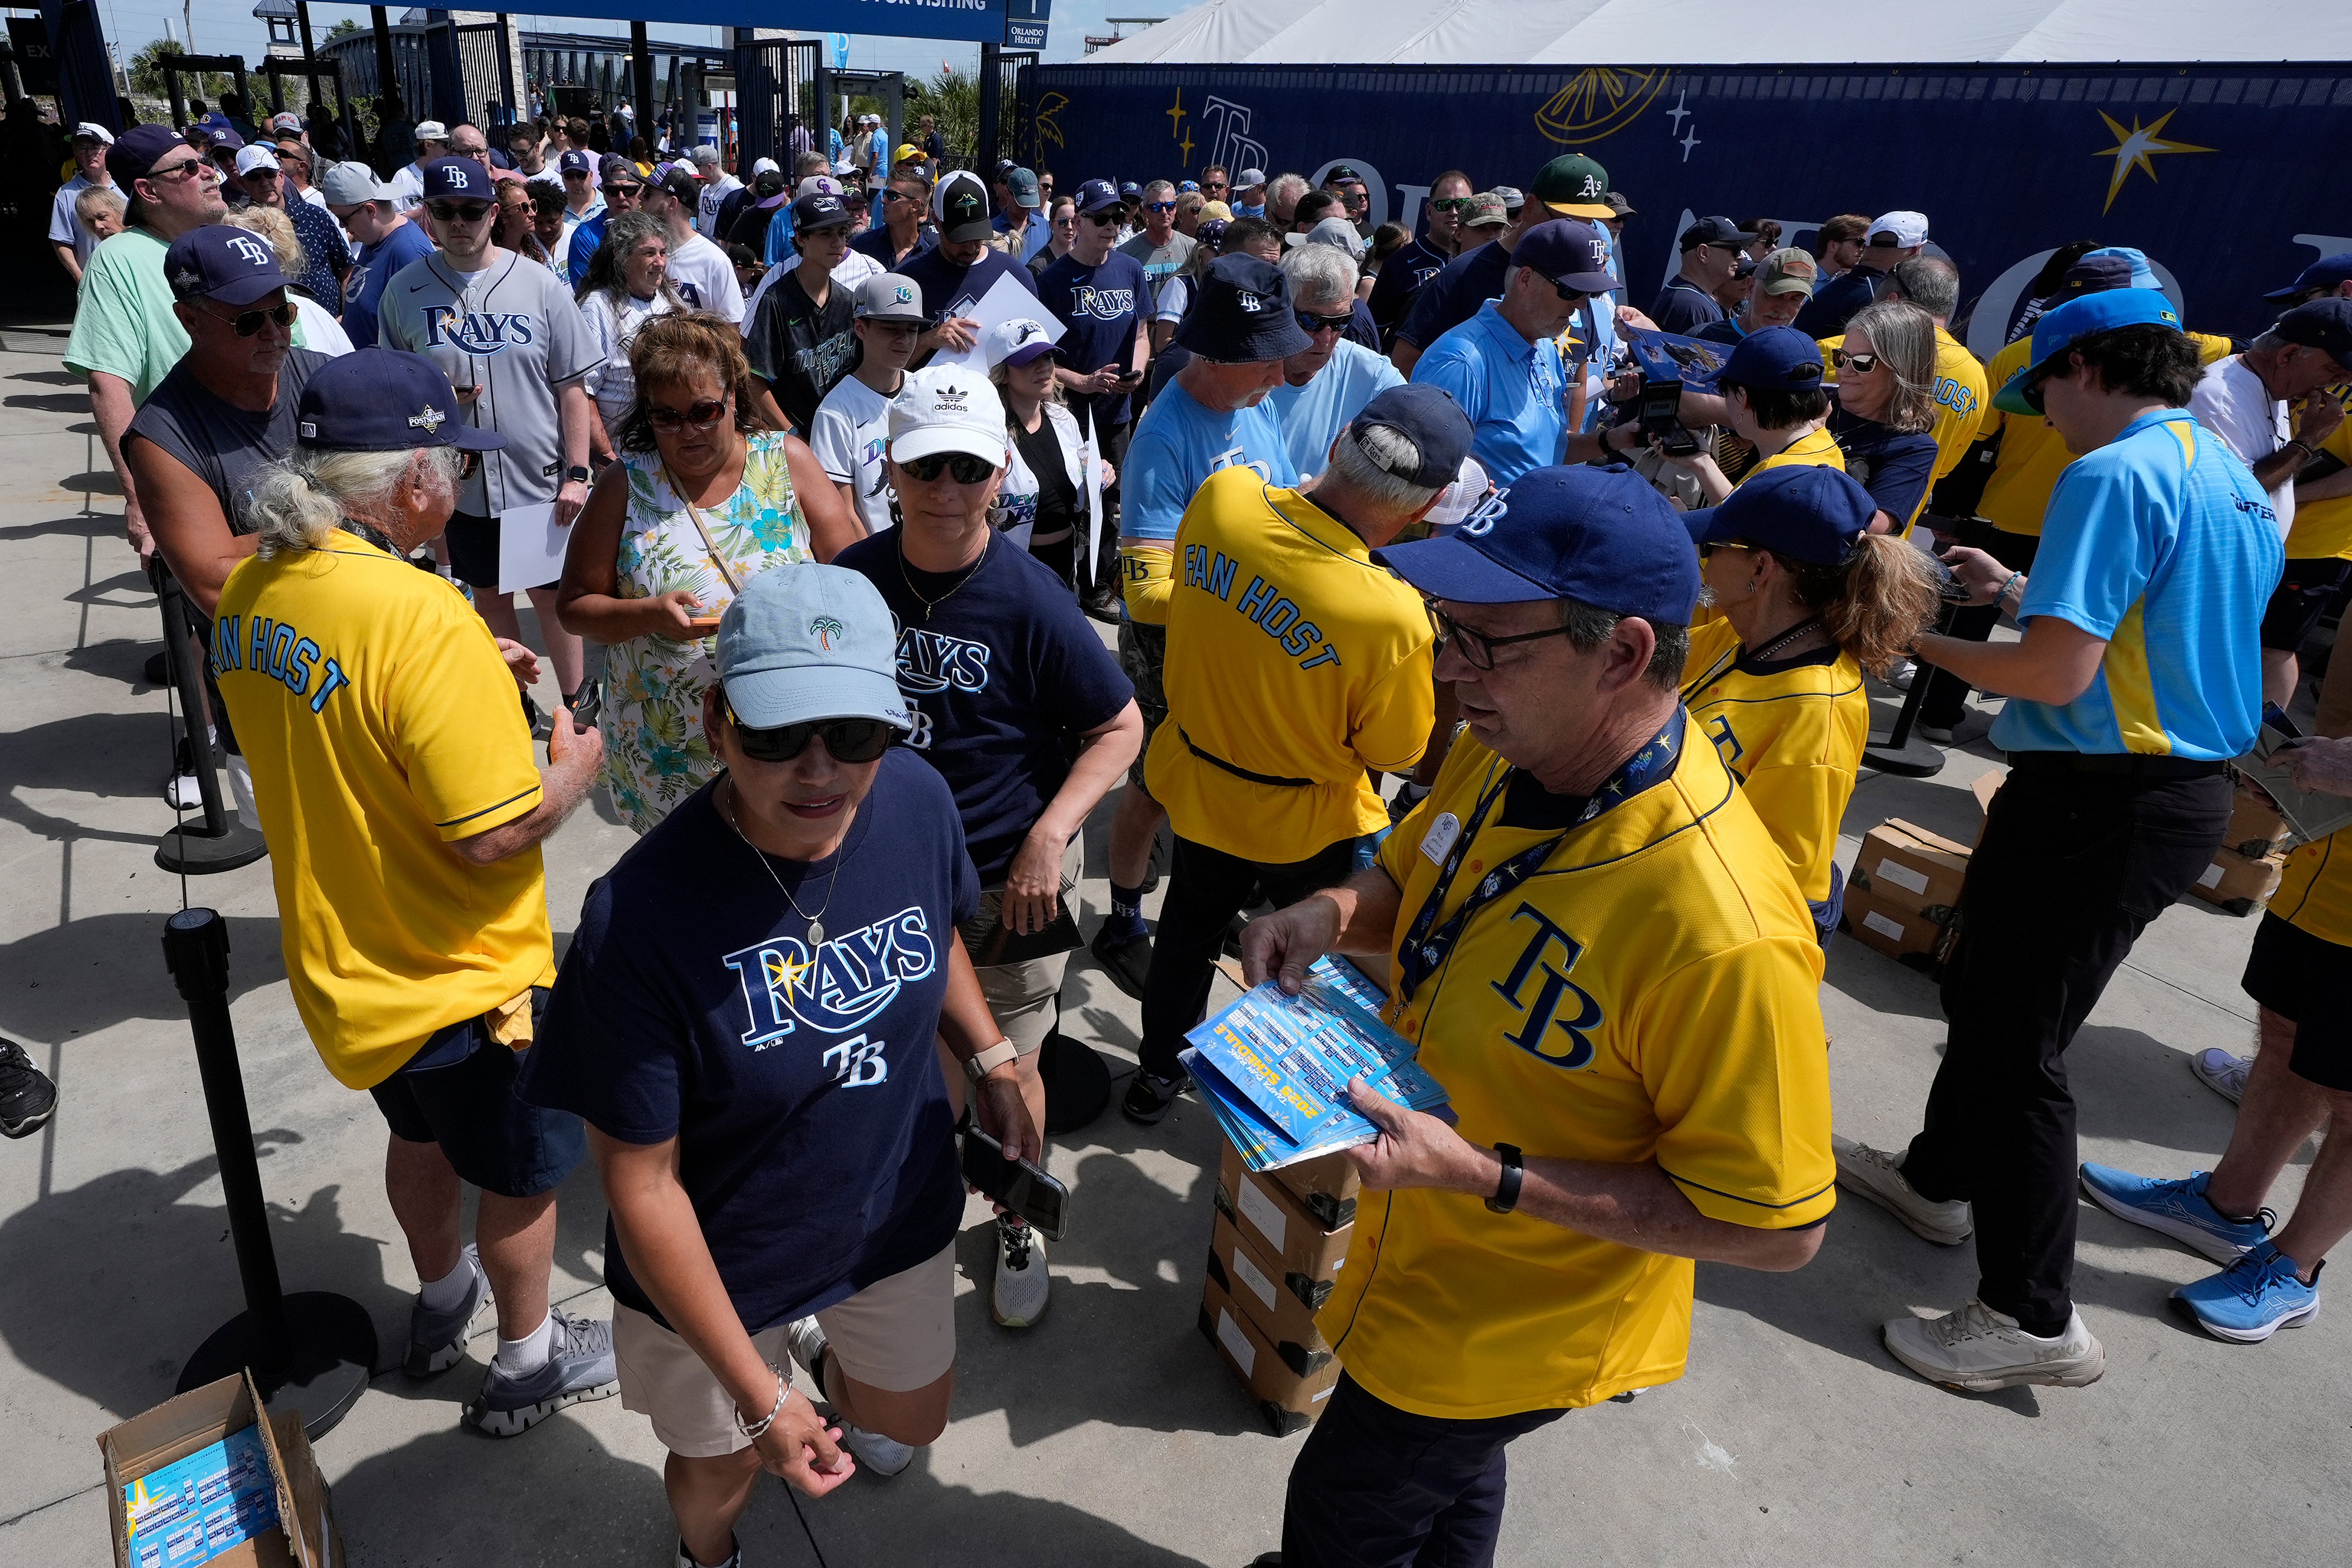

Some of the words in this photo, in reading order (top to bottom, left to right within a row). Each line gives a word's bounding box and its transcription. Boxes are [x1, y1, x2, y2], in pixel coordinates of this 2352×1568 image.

[1011, 26, 1044, 37] ORLANDO
[1015, 35, 1040, 45] HEALTH
[213, 129, 226, 140] TB
[567, 153, 580, 164] TB
[914, 166, 925, 175] TB
[442, 165, 469, 189] TB
[1098, 181, 1115, 195] TB
[226, 236, 269, 265] TB
[1589, 240, 1605, 265] TB
[1155, 263, 1178, 273] TAMPA
[1071, 286, 1133, 320] RAYS
[1237, 290, 1261, 312] TB
[420, 305, 534, 357] RAYS
[790, 329, 852, 374] TAMPA
[935, 402, 968, 412] adidas
[408, 413, 445, 426] POSTSEASON
[1368, 446, 1382, 461] RAYS
[1121, 556, 1149, 581] TB
[1184, 543, 1239, 602] FAN
[1236, 575, 1342, 671] HOST
[211, 614, 242, 680] AN
[250, 615, 350, 714] HOST
[892, 612, 990, 694] AYS
[722, 906, 936, 1047] RAYS
[1490, 899, 1606, 1071] TB
[823, 1033, 889, 1088] TB
[1213, 1022, 1281, 1085] SCHEDULE
[1226, 1048, 1248, 1066] RAYS
[1243, 1074, 1256, 1090] TB
[1245, 1066, 1264, 1081] BAY
[1262, 1080, 1288, 1106] TAMPA
[1279, 1084, 1319, 1120] 2025
[2034, 1340, 2084, 1362] HOKA
